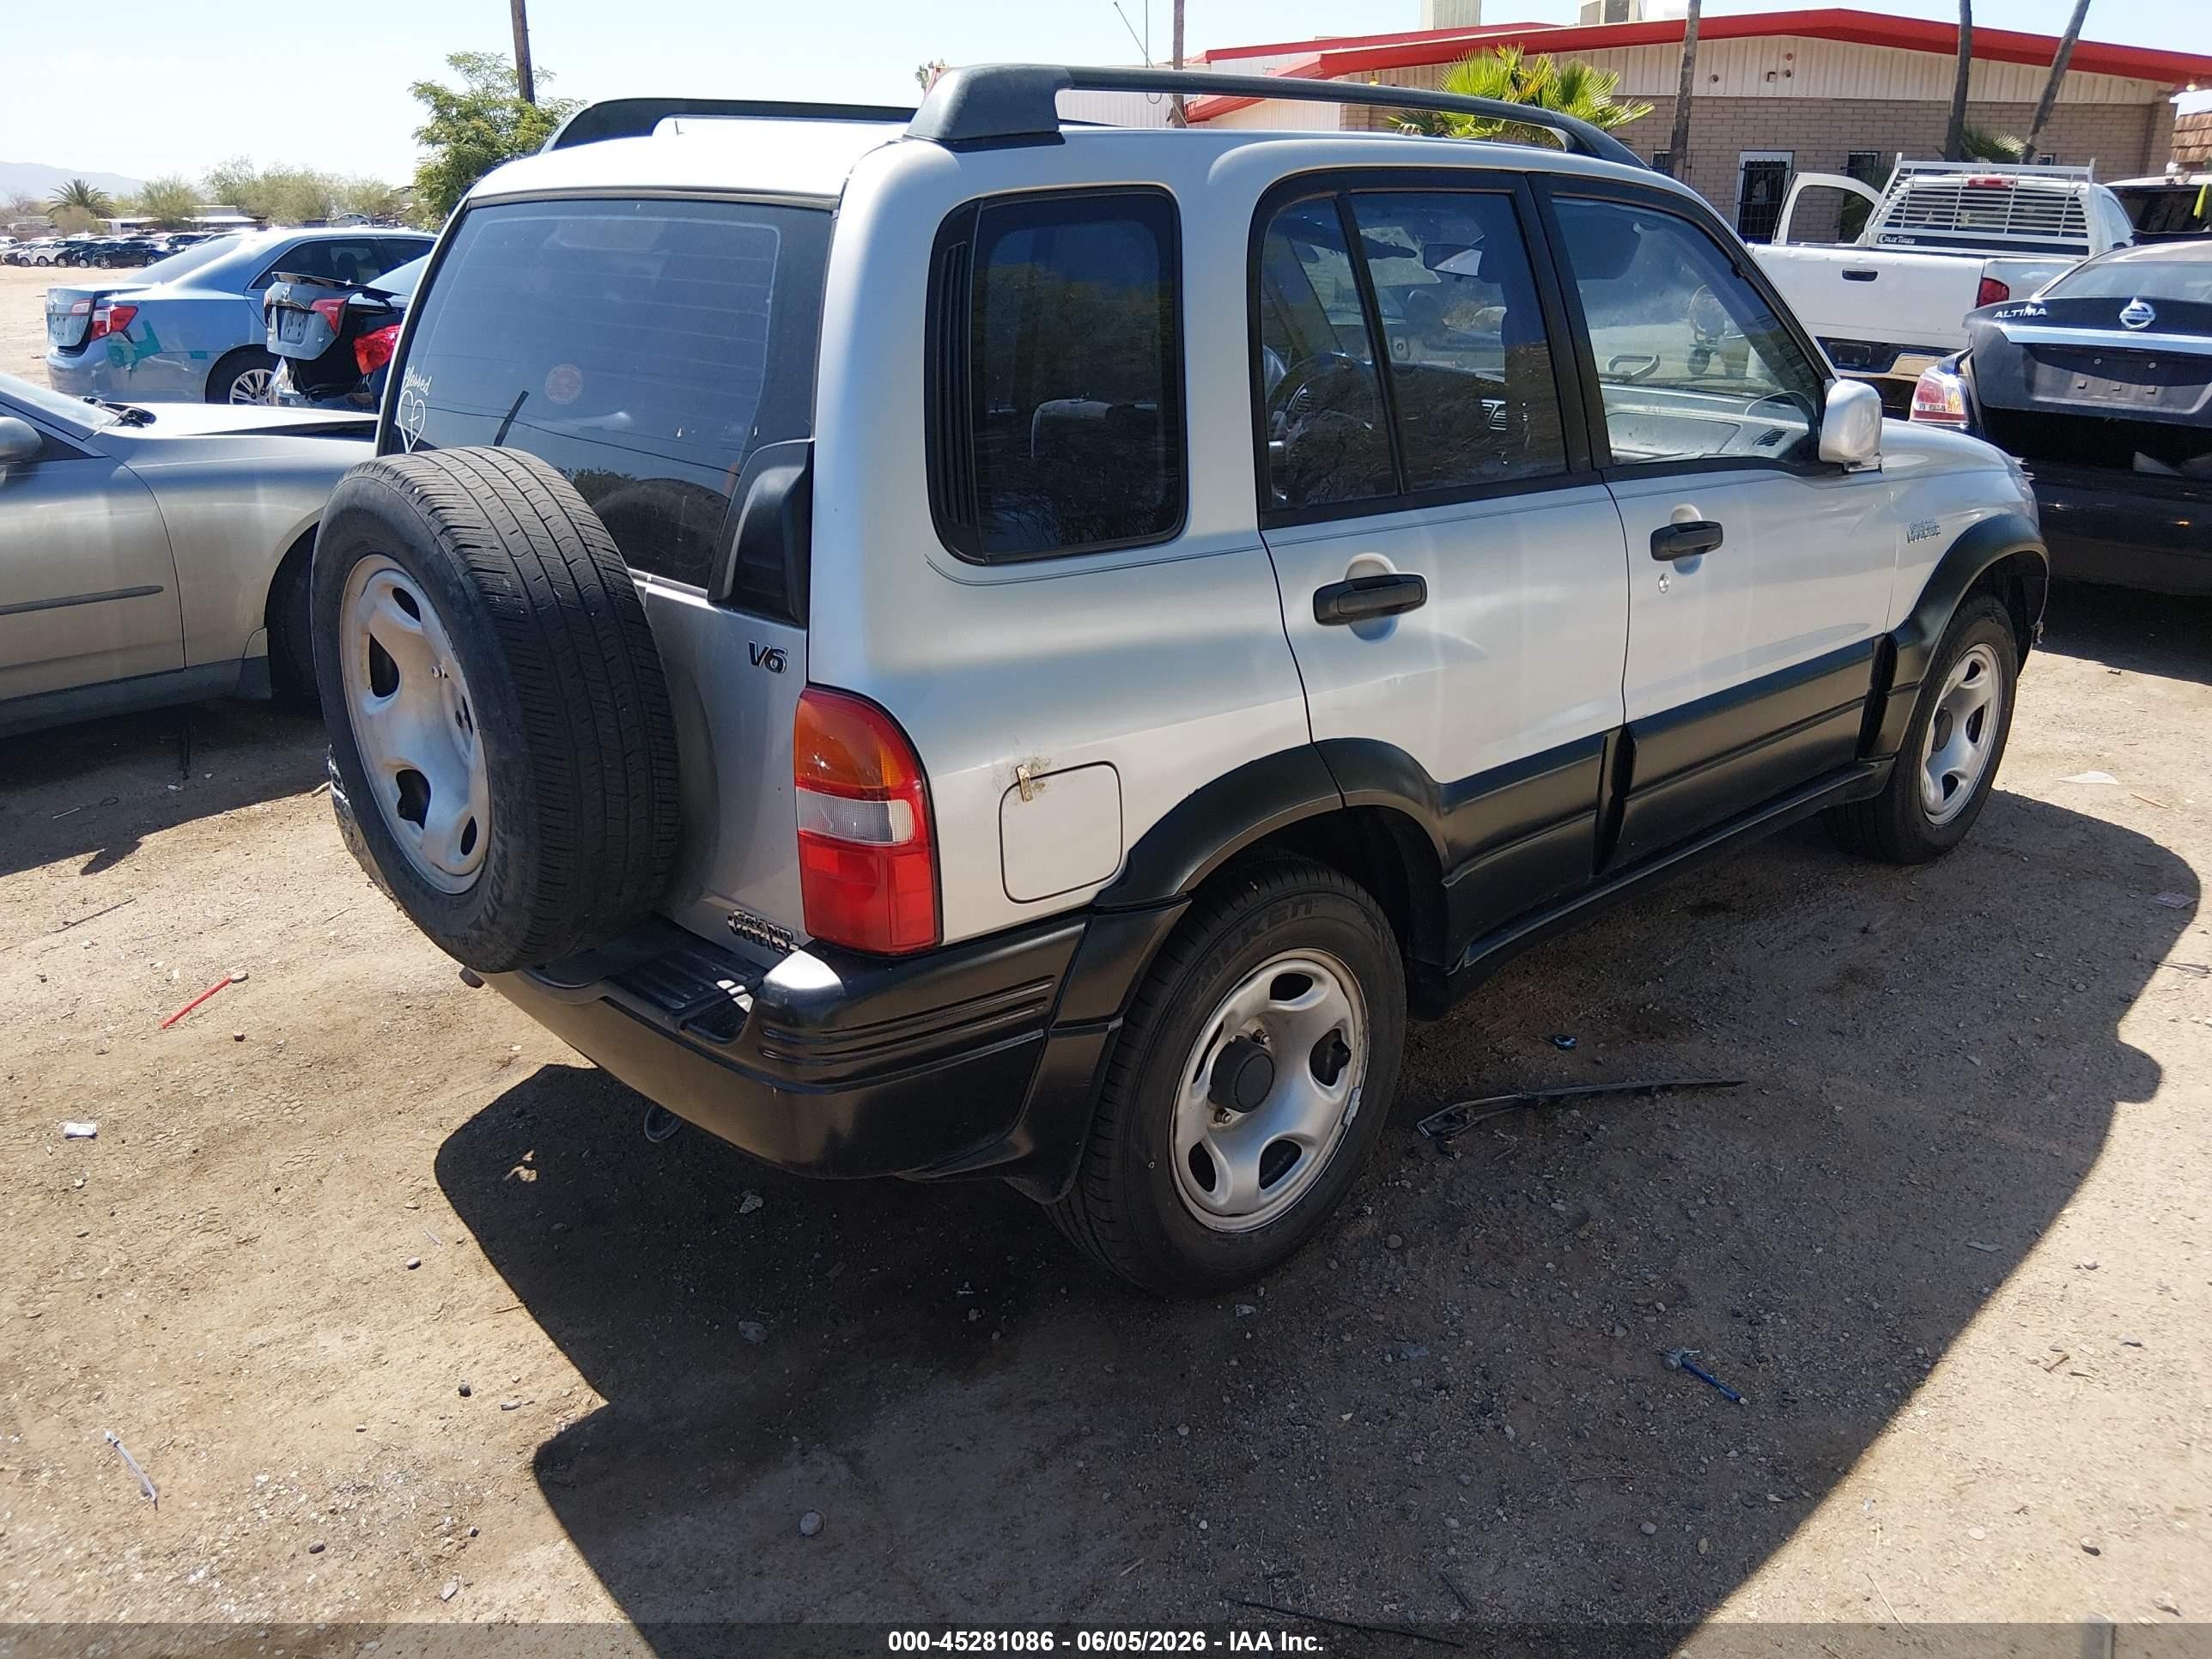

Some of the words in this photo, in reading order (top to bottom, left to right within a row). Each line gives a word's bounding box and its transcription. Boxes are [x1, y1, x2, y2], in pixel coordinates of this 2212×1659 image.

[1992, 307, 2047, 319] ALTIMA
[748, 640, 788, 674] V6
[732, 909, 794, 943] GRAND
